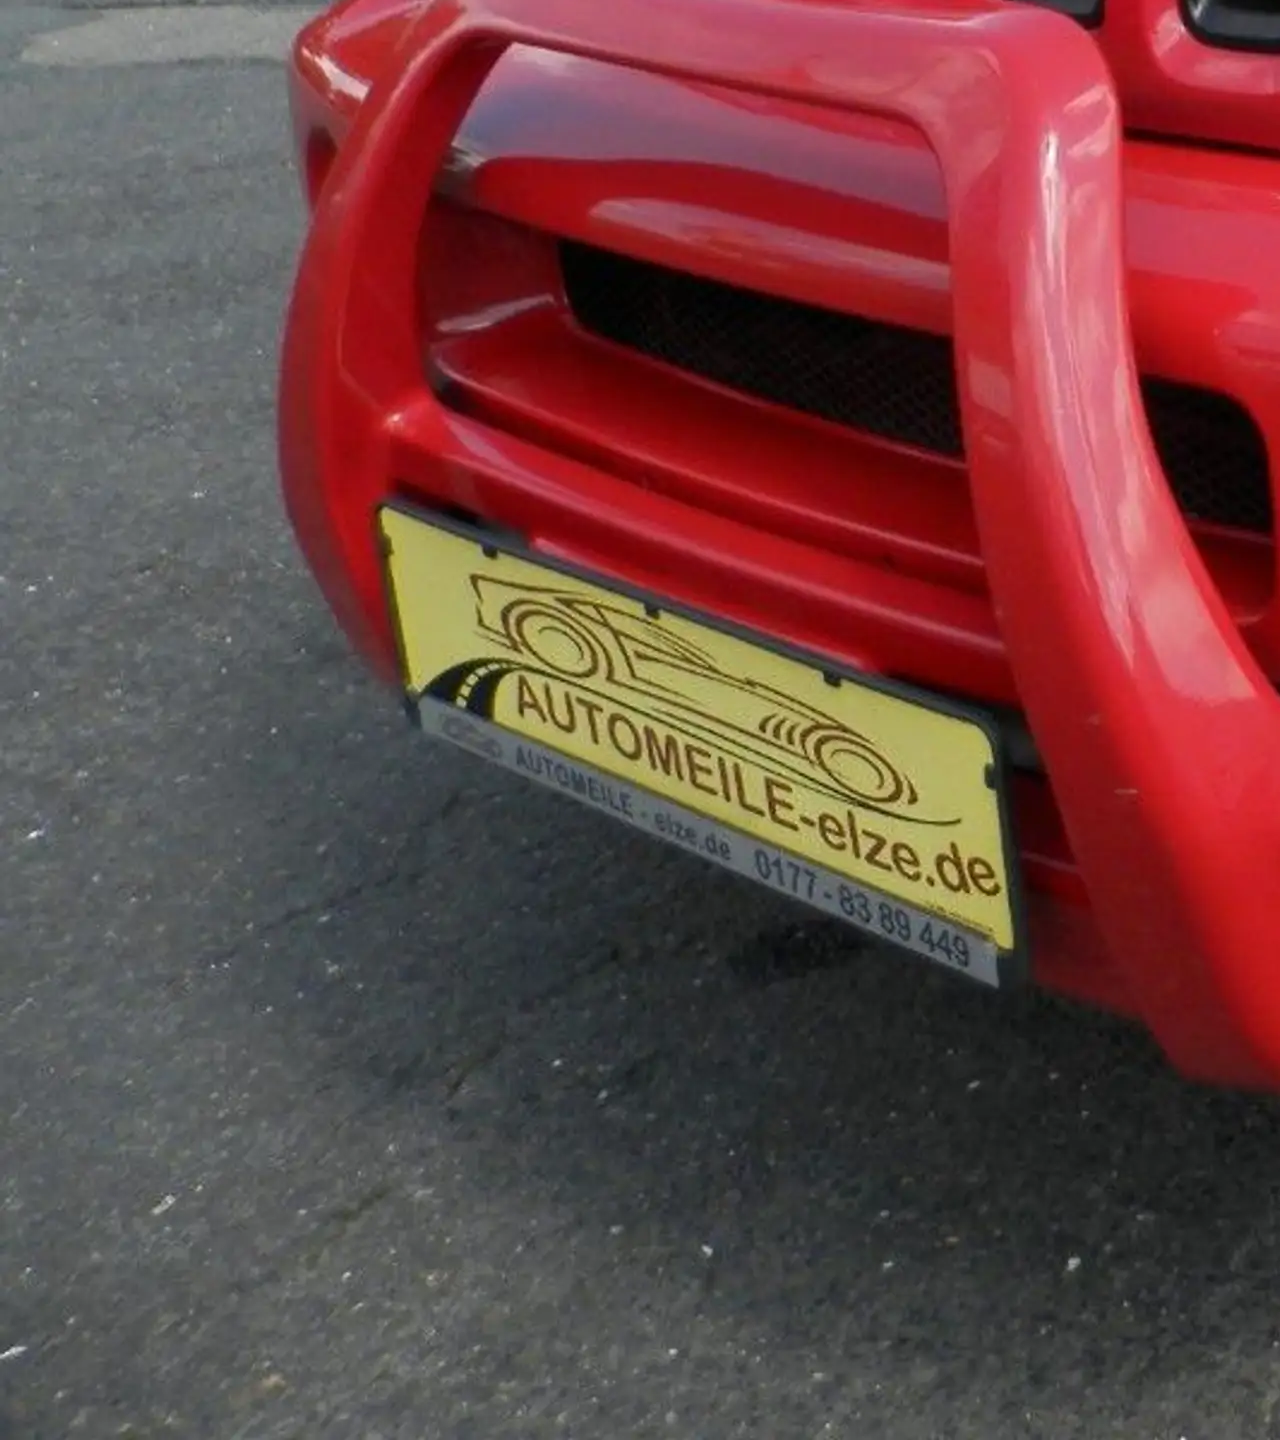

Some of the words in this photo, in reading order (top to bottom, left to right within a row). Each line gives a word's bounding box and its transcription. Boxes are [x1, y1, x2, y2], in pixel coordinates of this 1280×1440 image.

[515, 744, 634, 820] AUTOMEILE
[653, 810, 732, 862] elze.de
[754, 849, 818, 900] 0177
[838, 882, 874, 925] 83
[878, 901, 912, 943] 89
[918, 921, 970, 968] 449
[516, 674, 1001, 897] AUTOMEILE-elze.de
